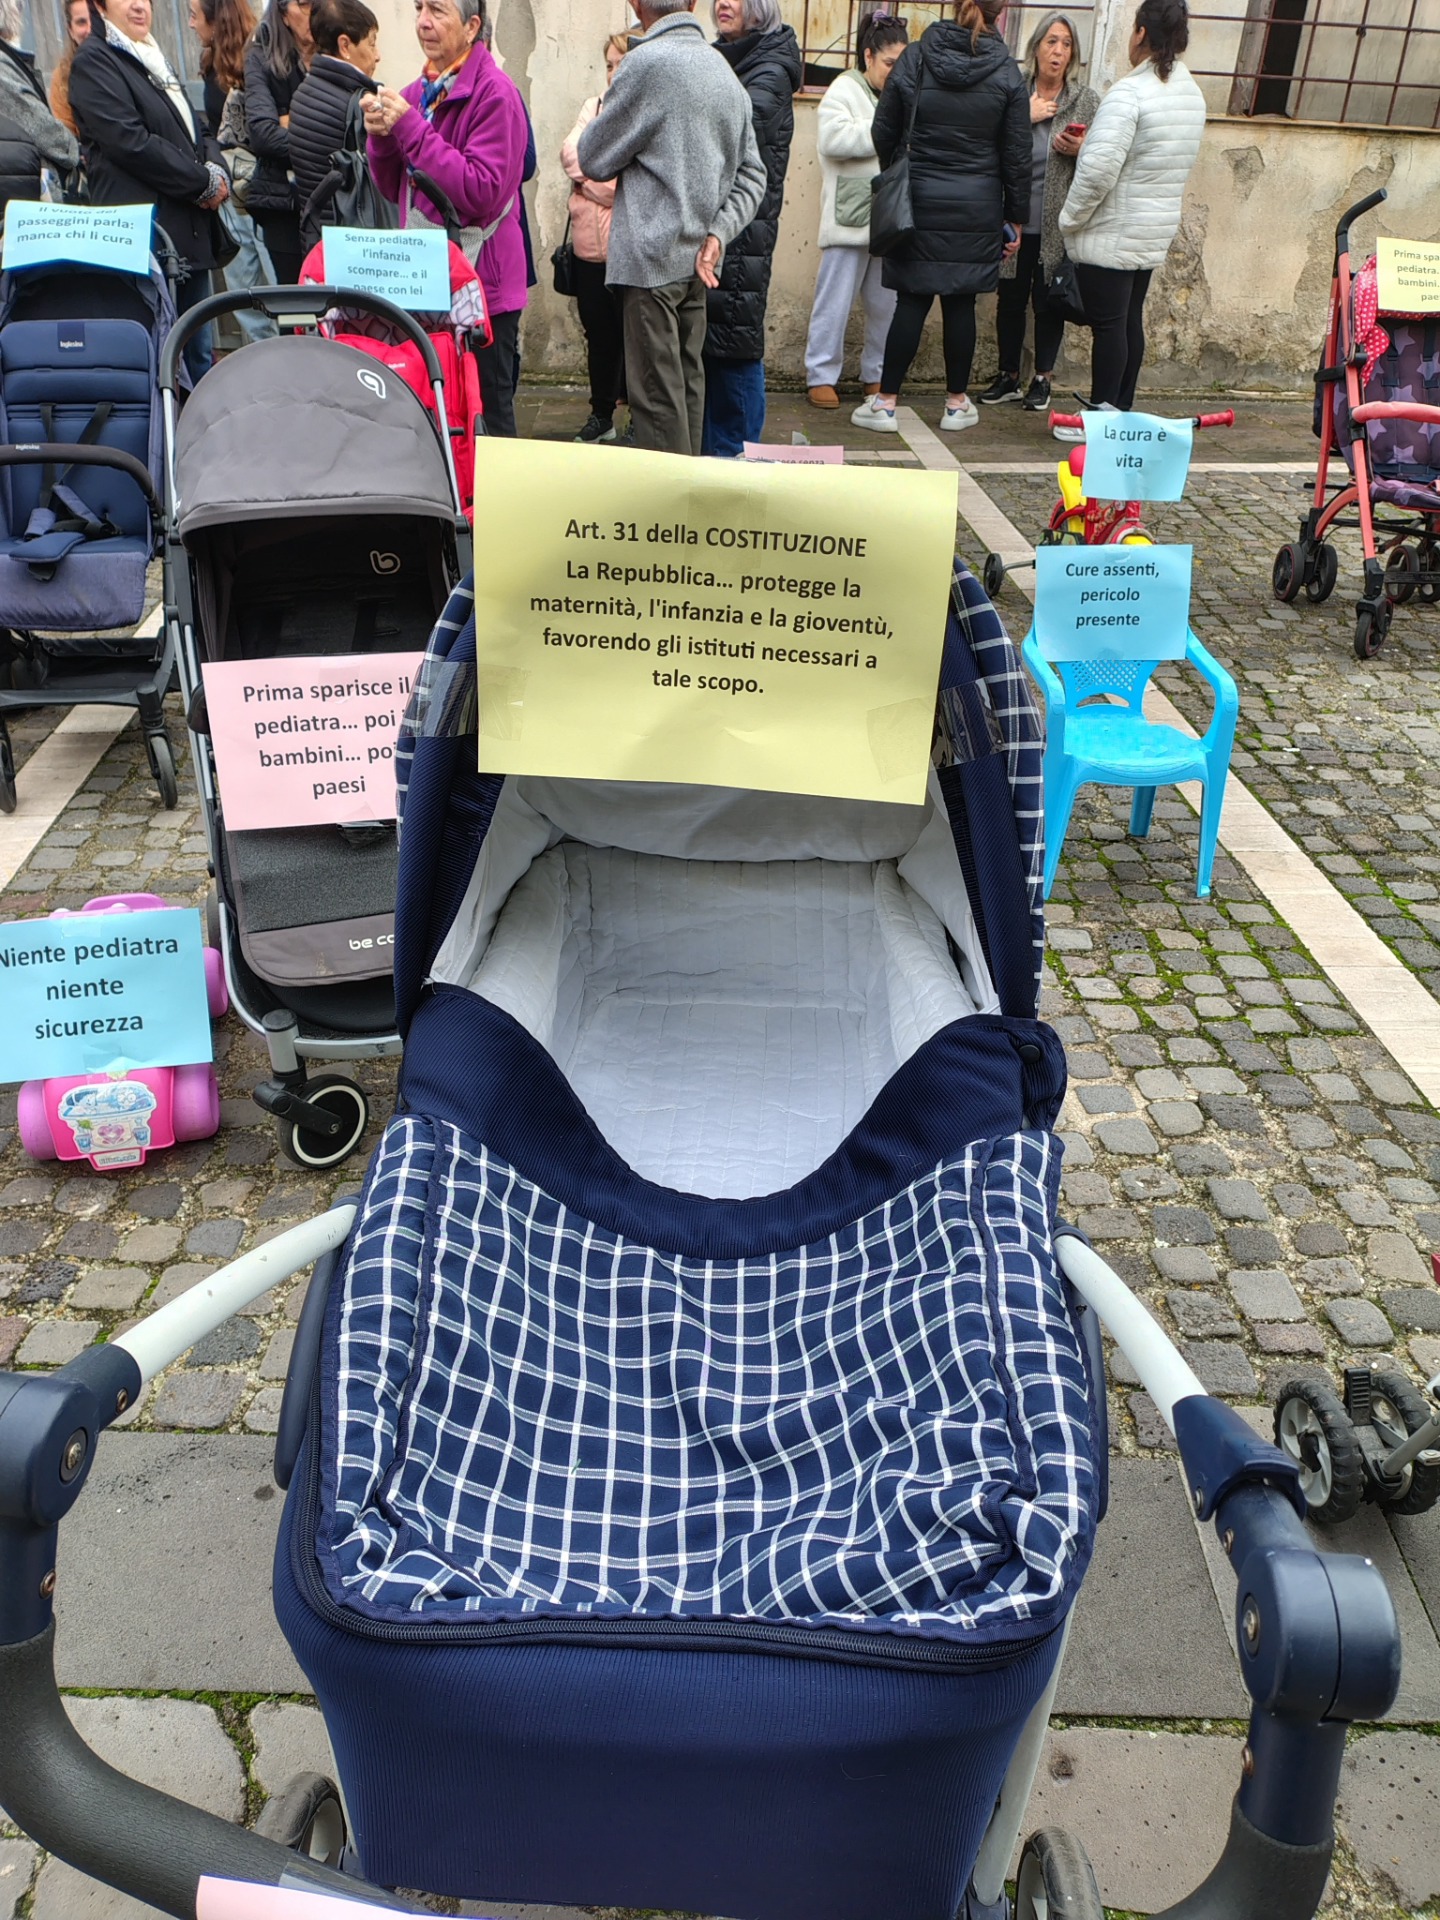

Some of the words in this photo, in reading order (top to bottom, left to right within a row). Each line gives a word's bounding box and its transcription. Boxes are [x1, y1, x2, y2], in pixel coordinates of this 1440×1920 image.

[17, 216, 90, 228] passeggini
[93, 218, 135, 230] parla:
[17, 231, 61, 243] manca
[65, 230, 86, 239] chi
[102, 234, 133, 245] cura
[345, 234, 376, 243] Senza
[379, 235, 427, 247] pediatra,
[1394, 250, 1421, 260] Prima
[412, 271, 418, 279] e
[420, 269, 428, 279] il
[387, 286, 408, 295] con
[409, 285, 424, 296] lei
[1421, 294, 1440, 302] pae
[1104, 425, 1117, 440] La
[1119, 430, 1152, 442] cura
[1156, 427, 1168, 443] è
[1116, 453, 1143, 468] vita
[564, 518, 606, 540] Art.
[613, 521, 639, 542] 31
[646, 522, 699, 545] della
[705, 527, 867, 558] COSTITUZIONE
[567, 560, 589, 580] La
[596, 561, 733, 589] Repubblica...
[740, 574, 836, 600] protegge
[842, 577, 861, 598] la
[1065, 563, 1100, 577] Cure
[1103, 562, 1160, 578] assenti,
[1080, 587, 1140, 605] pericolo
[530, 596, 642, 621] maternità,
[649, 598, 744, 624] l'infanzia
[750, 611, 763, 626] e
[769, 607, 787, 628] la
[792, 610, 893, 640] gioventù,
[1075, 613, 1140, 630] presente
[542, 626, 651, 652] favorendo
[656, 634, 682, 657] gli
[688, 636, 756, 659] istituti
[761, 646, 860, 668] necessari
[865, 655, 878, 669] a
[243, 683, 304, 703] Prima
[310, 678, 393, 702] sparisce
[398, 676, 411, 694] il
[651, 668, 692, 688] tale
[697, 675, 764, 696] scopo.
[254, 715, 358, 740] pediatra...
[364, 709, 396, 733] poi
[259, 744, 361, 768] bambini...
[312, 775, 366, 800] paesi
[0, 943, 67, 968] Niente
[74, 936, 179, 966] pediatra
[46, 978, 124, 1001] niente
[35, 1015, 144, 1040] sicurezza
